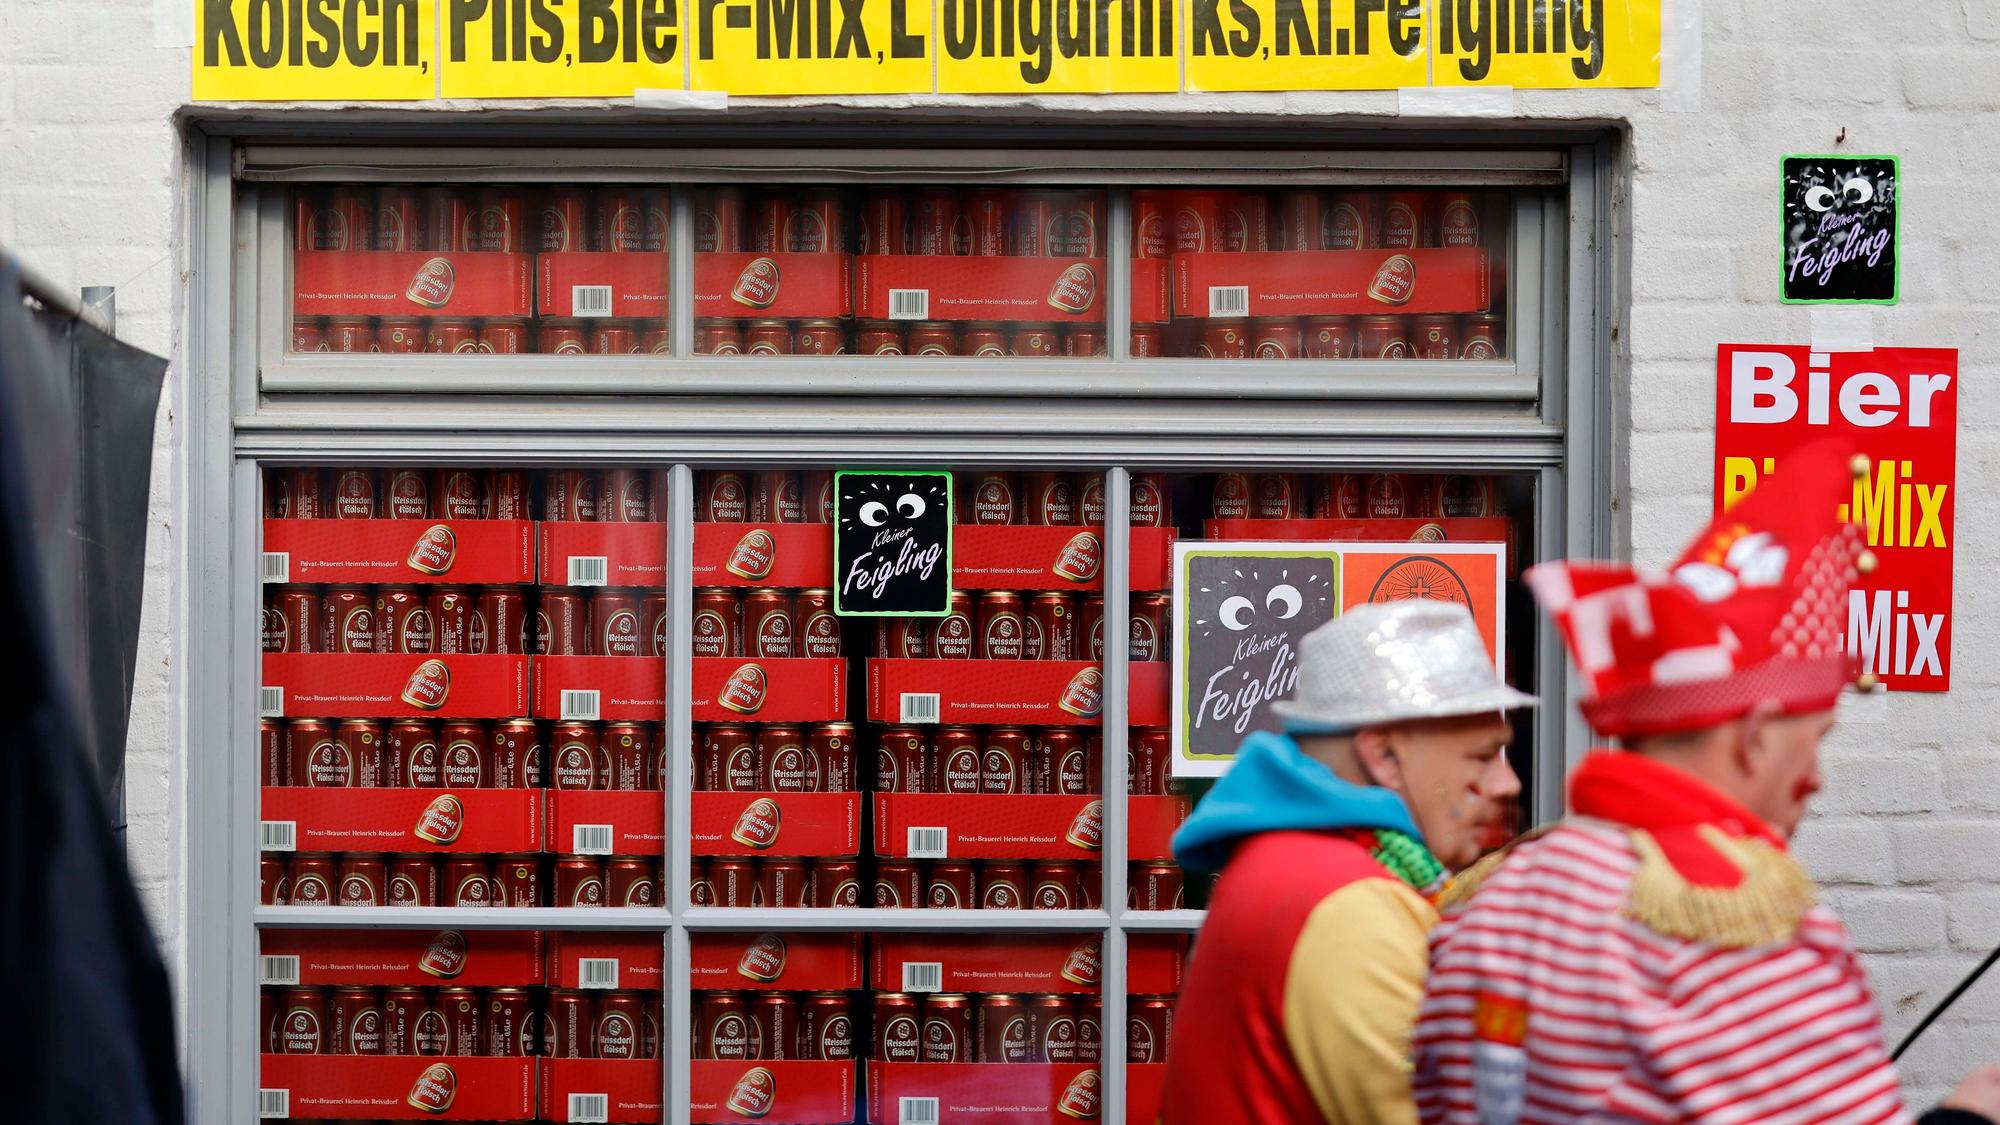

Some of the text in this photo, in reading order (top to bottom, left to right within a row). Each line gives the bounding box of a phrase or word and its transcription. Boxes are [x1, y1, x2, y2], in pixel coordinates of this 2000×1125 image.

[1817, 212, 1860, 235] Kleiner
[1789, 222, 1891, 286] Feigling
[1731, 351, 1952, 428] Bier
[871, 526, 913, 550] Kleiner
[843, 536, 943, 599] Feigling
[1232, 631, 1289, 664] Kleiner
[1195, 643, 1304, 734] Feiglin
[378, 829, 405, 837] Reissdorf
[695, 833, 722, 841] Reissdorf
[356, 963, 381, 971] Heinrich
[382, 963, 409, 971] Reissdorf
